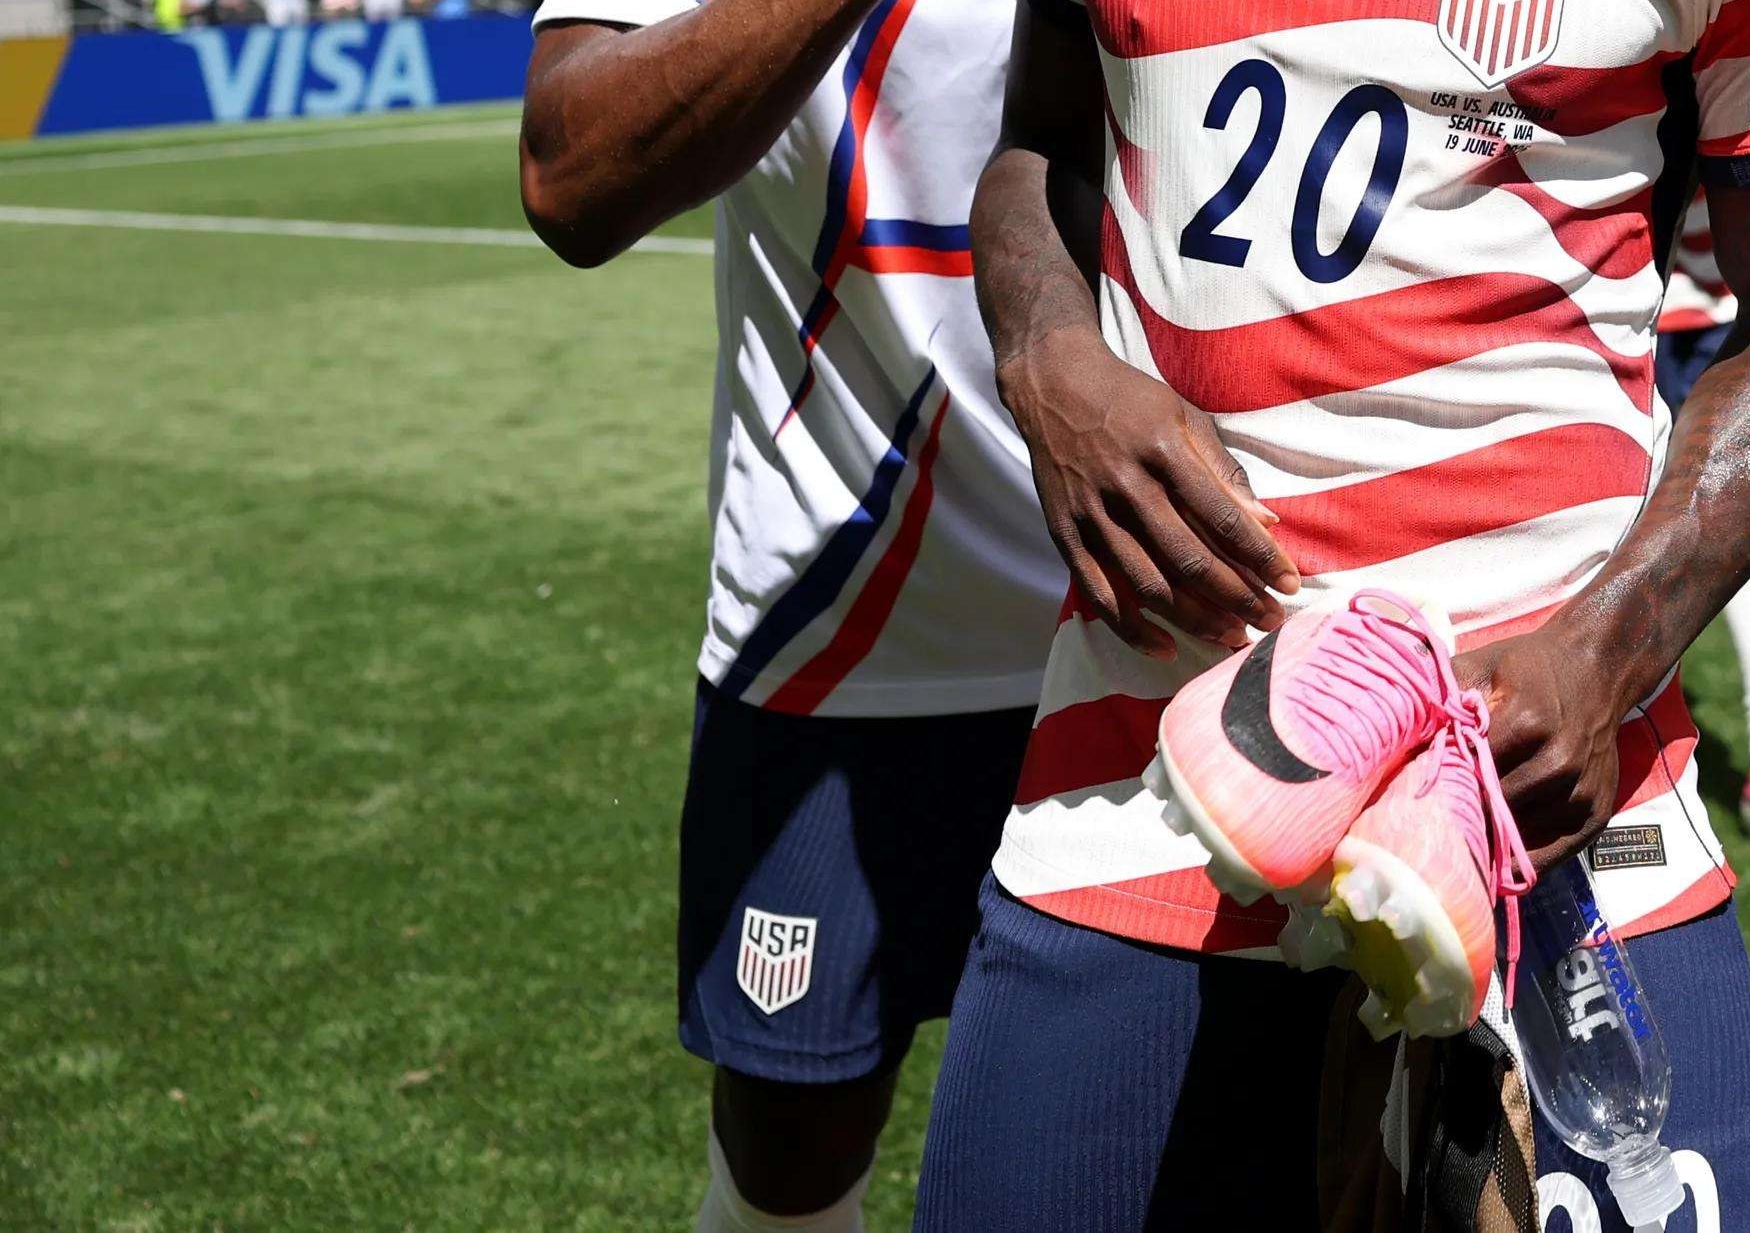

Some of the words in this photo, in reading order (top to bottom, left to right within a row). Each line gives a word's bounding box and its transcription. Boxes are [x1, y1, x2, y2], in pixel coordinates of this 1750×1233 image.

[176, 18, 437, 123] VISA
[1430, 91, 1457, 109] USA
[1462, 97, 1482, 114] VS.
[1448, 115, 1507, 141] SEATTLE,
[1513, 124, 1534, 141] WA
[1444, 134, 1459, 150] 19
[1462, 138, 1499, 157] JUNE
[1179, 58, 1409, 283] 20
[748, 915, 809, 957] USA
